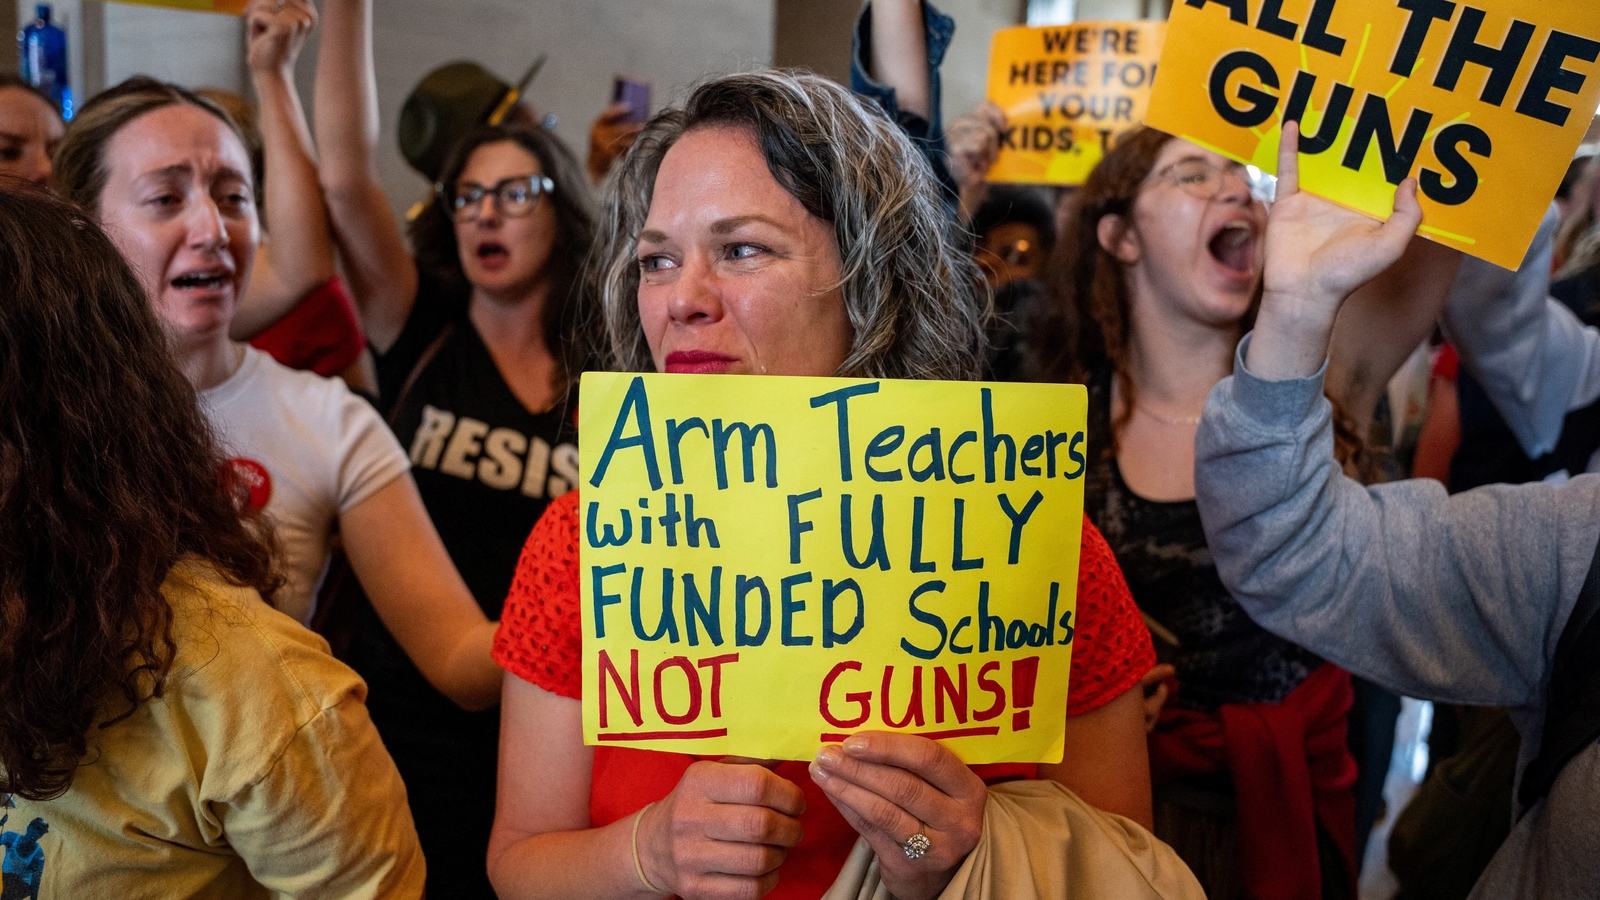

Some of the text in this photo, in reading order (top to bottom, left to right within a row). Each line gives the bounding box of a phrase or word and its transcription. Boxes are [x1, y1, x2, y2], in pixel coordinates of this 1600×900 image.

[1009, 61, 1158, 87] HERE FO
[1043, 29, 1139, 53] WE'RE
[1185, 0, 1600, 127] LL THE
[1039, 94, 1133, 121] YOUR
[1209, 51, 1492, 206] GUNS
[590, 376, 1086, 490] Arm Teachers
[586, 488, 1044, 572] with FULLY
[592, 563, 1074, 660] FUNDED Schools
[598, 649, 1040, 732] NOT GUNS!
